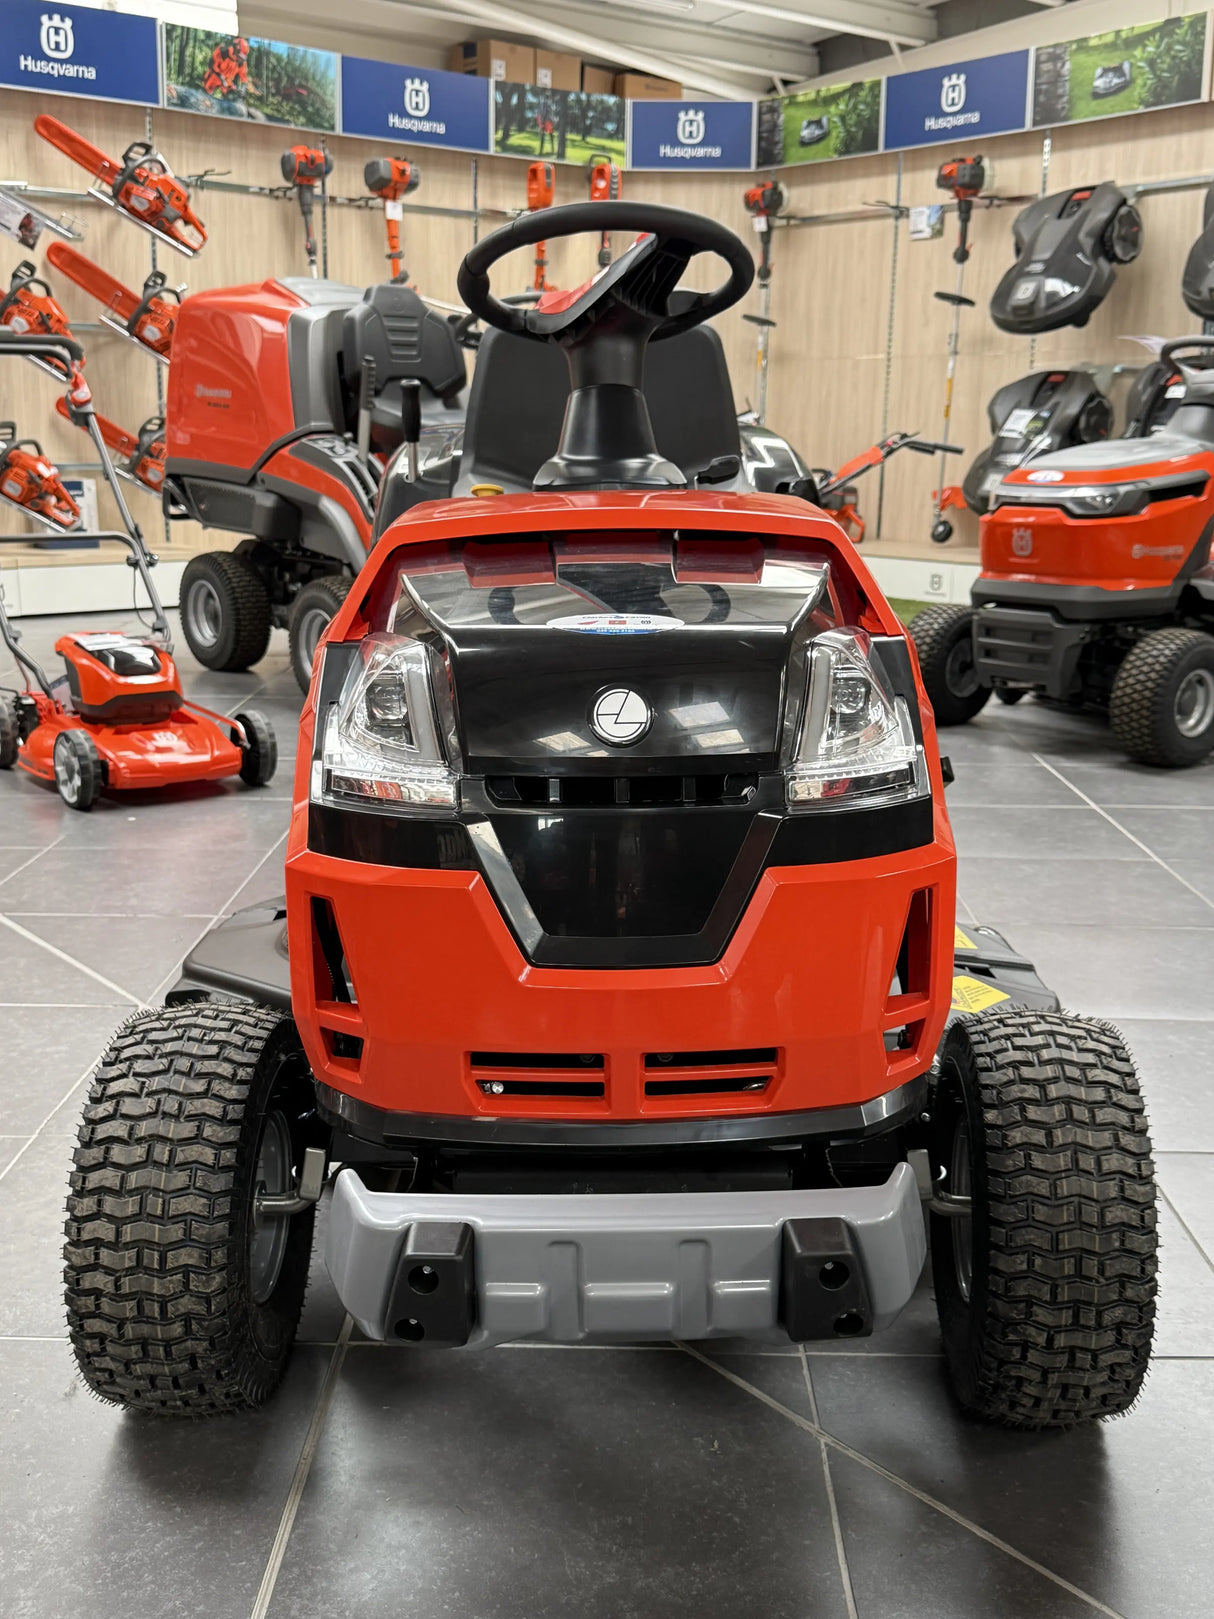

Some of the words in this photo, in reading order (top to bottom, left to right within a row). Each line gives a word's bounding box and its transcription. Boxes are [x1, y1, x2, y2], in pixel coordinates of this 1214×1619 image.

[19, 54, 97, 80] Husqvarna
[388, 112, 446, 135] Husqvarna
[924, 111, 981, 131] Husqvarna
[659, 144, 722, 159] Husqvarna
